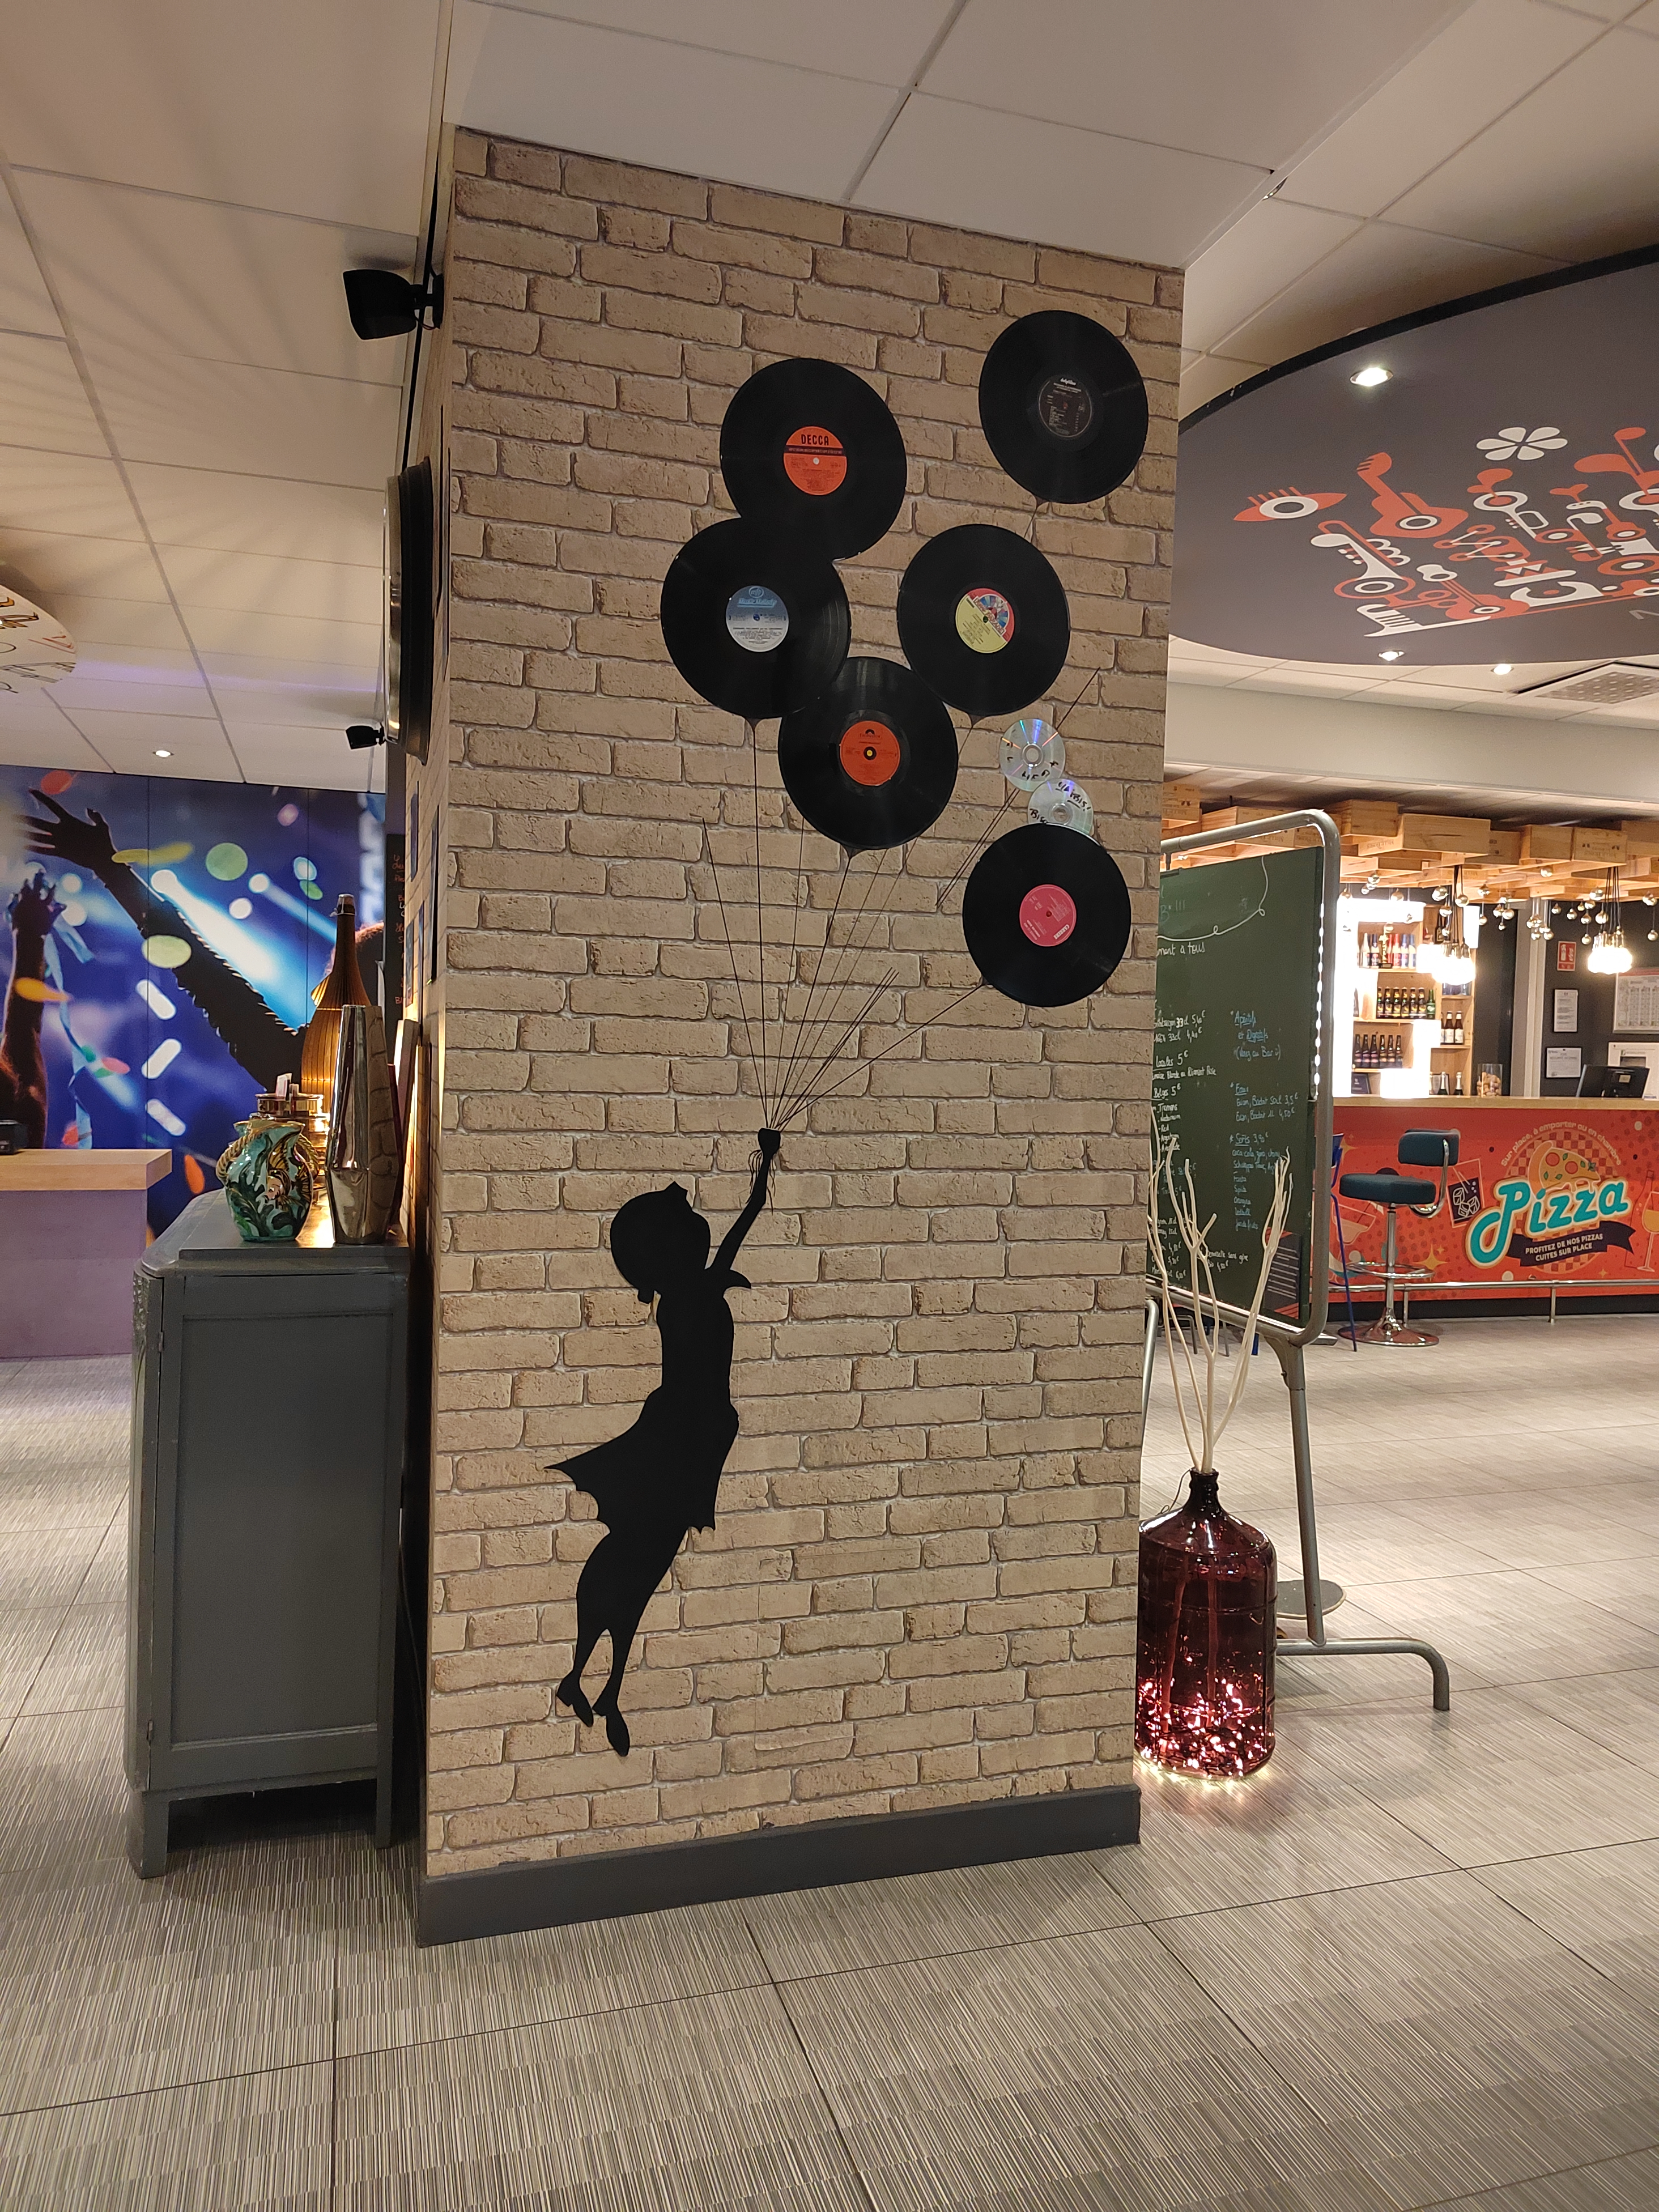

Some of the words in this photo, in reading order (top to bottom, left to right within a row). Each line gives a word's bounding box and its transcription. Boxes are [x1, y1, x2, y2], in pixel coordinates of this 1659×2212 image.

[801, 433, 829, 446] DECCA
[1157, 943, 1176, 956] ment
[1501, 1151, 1513, 1167] Sur
[1512, 1133, 1533, 1153] place,
[1539, 1121, 1576, 1132] emporter
[1588, 1128, 1597, 1137] en
[1597, 1134, 1621, 1165] chambre
[1470, 1181, 1629, 1264] Pizza
[1525, 1243, 1556, 1254] PROFITEZ
[1567, 1236, 1580, 1246] NOS
[1581, 1233, 1603, 1242] PIZZAS
[1535, 1250, 1558, 1261] CUITES
[1559, 1247, 1572, 1256] SUR
[1572, 1242, 1593, 1252] PLACE
